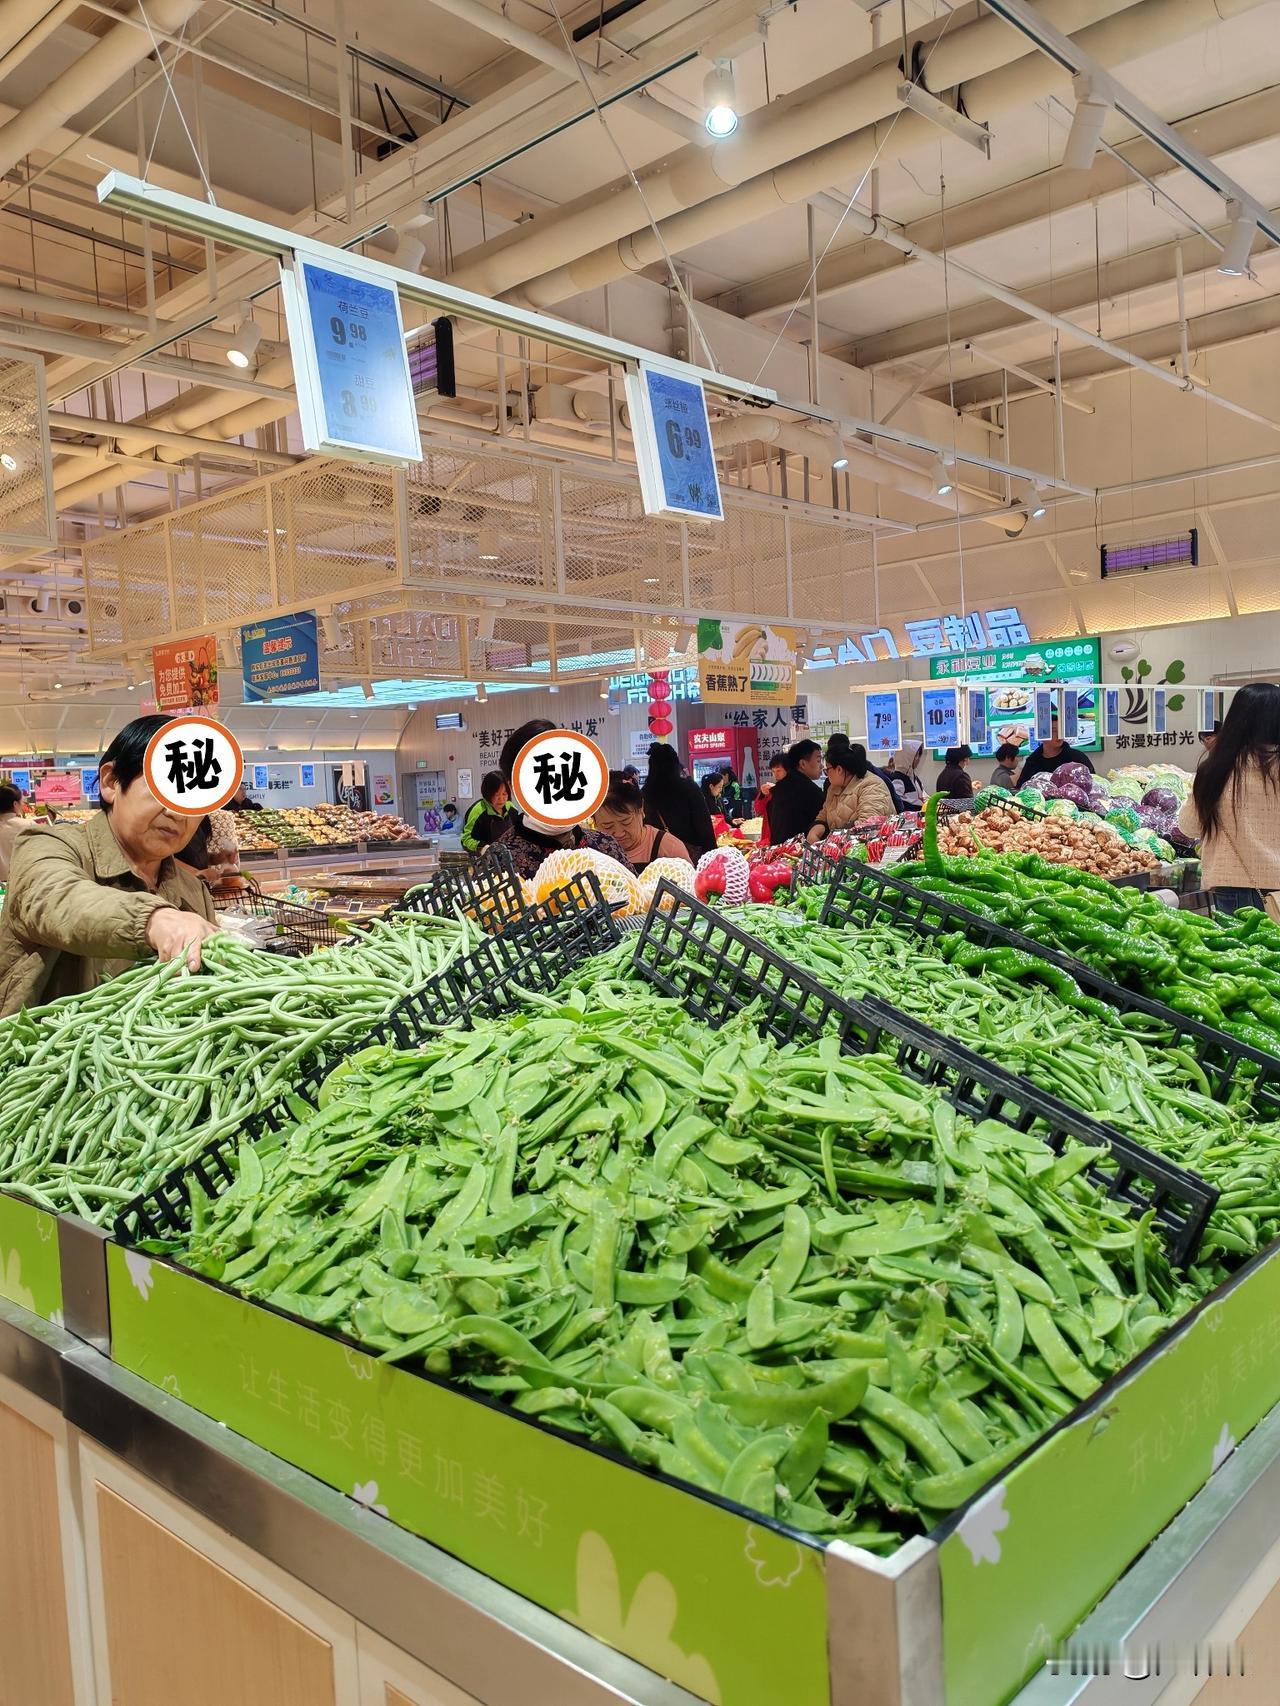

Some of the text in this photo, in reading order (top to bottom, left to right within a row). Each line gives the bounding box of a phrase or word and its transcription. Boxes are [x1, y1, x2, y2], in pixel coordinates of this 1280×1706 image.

[337, 300, 370, 320] 荷兰豆
[904, 606, 1031, 659] 豆制品
[158, 666, 186, 683] 为您提供
[705, 673, 748, 692] 香蕉熟了
[693, 731, 726, 744] 农夫山泉
[1115, 730, 1195, 750] 弥漫好时光
[238, 1350, 551, 1548] 让生活变得更加美好
